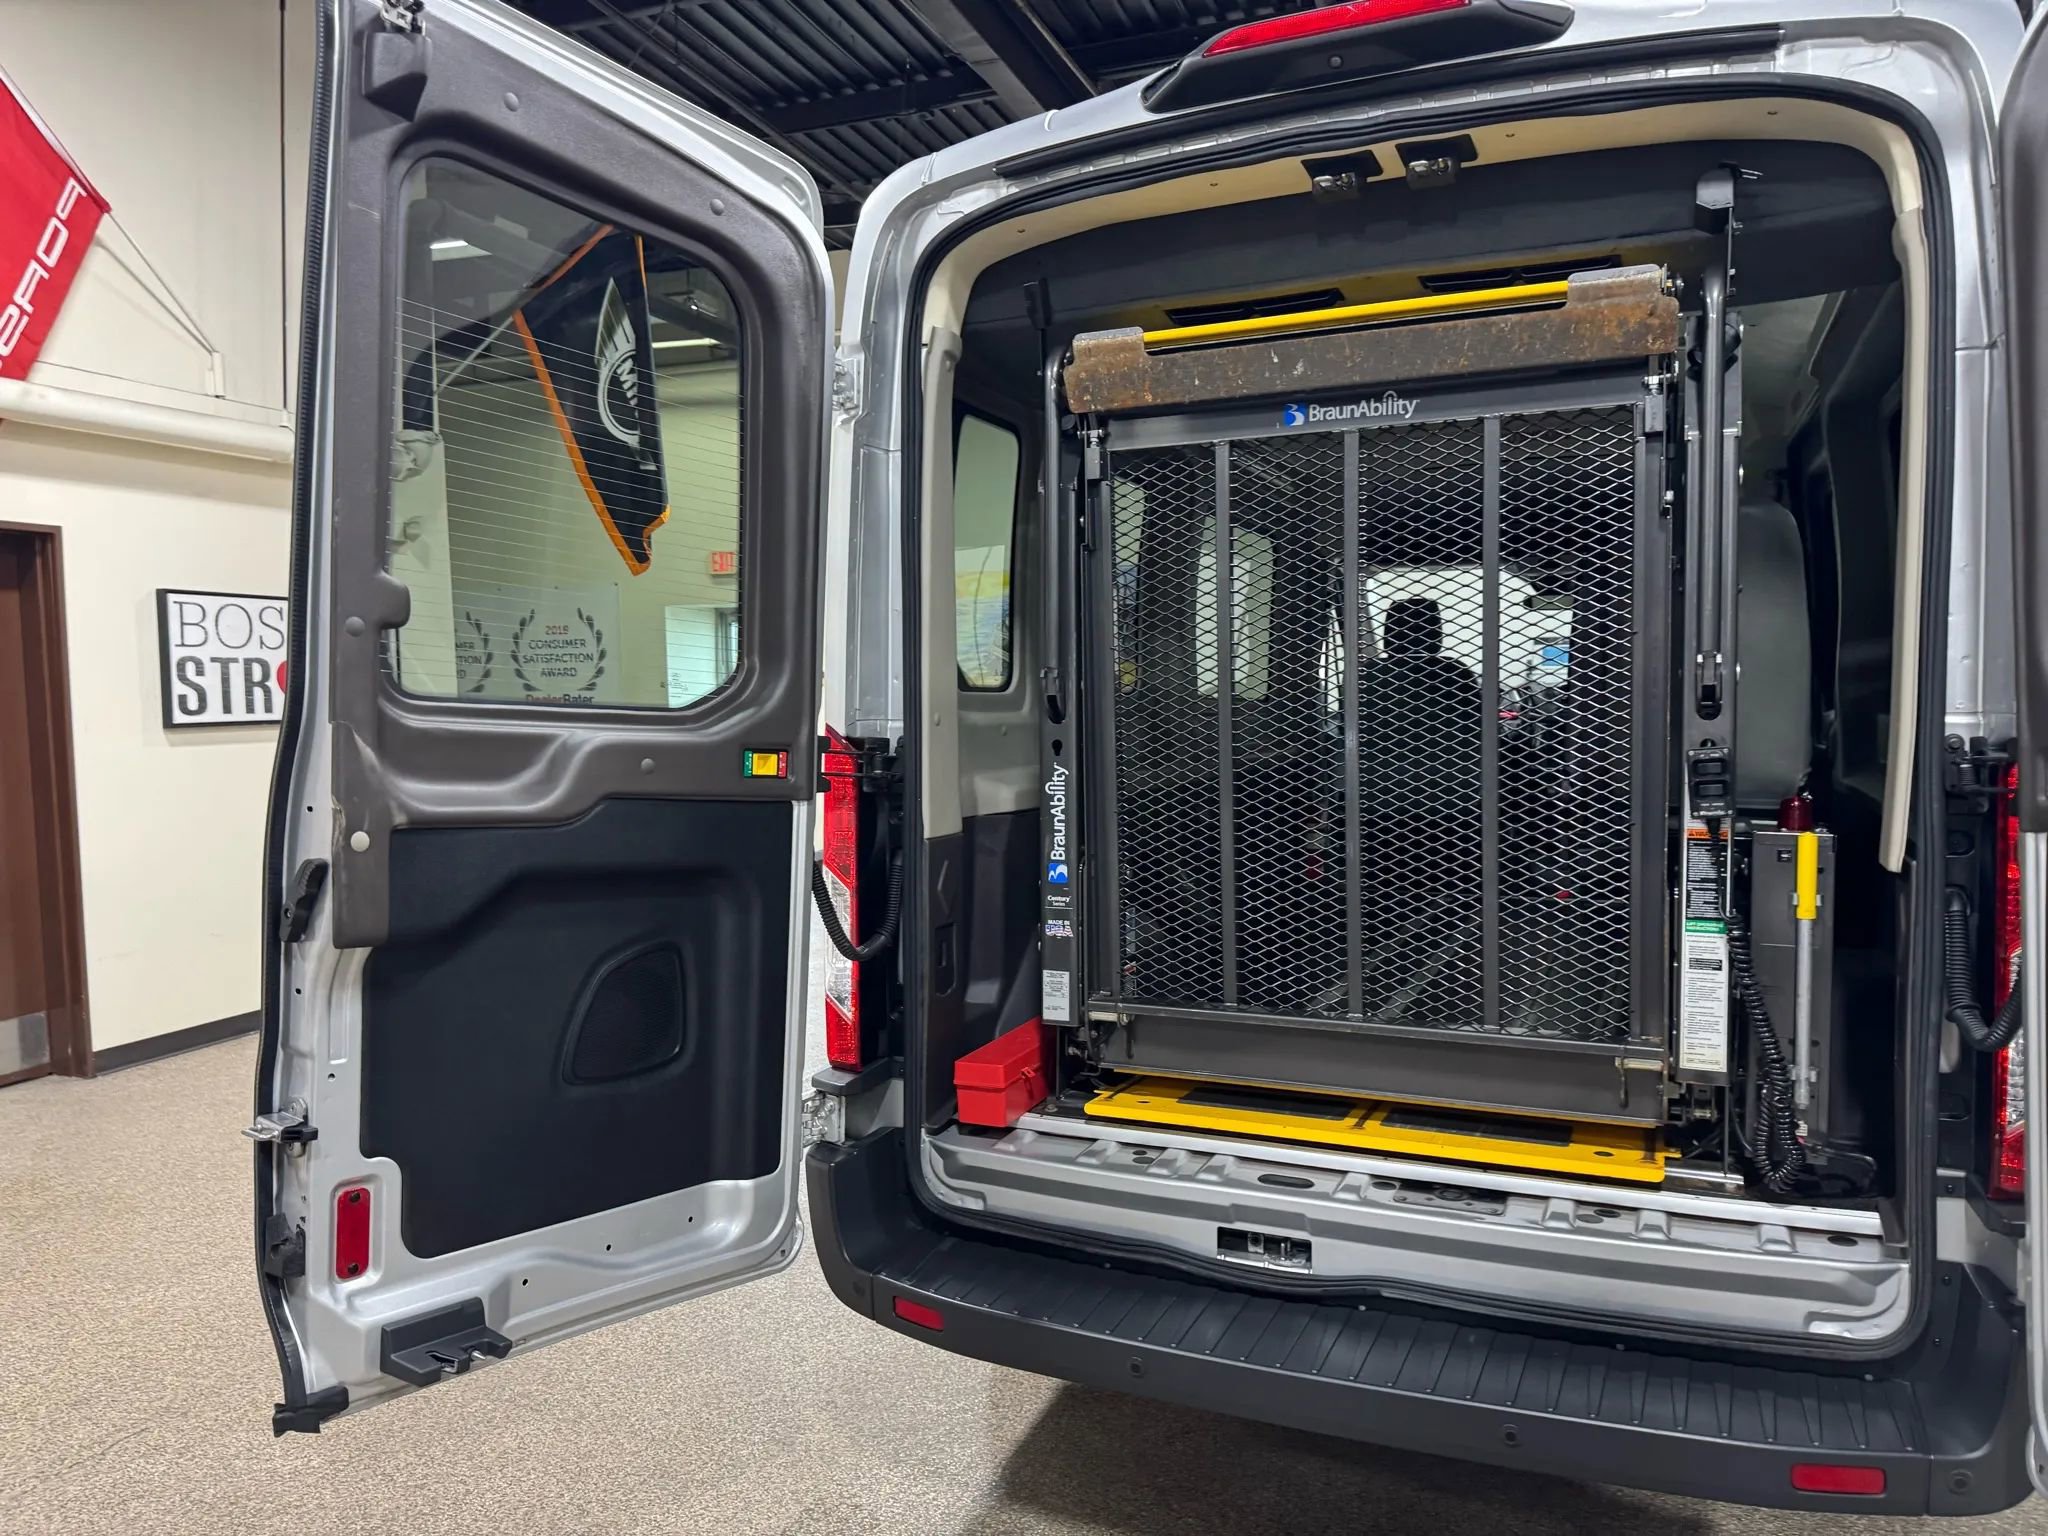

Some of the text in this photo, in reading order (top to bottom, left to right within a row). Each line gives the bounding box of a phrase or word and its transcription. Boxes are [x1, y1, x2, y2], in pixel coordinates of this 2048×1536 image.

[1309, 391, 1418, 421] BraunAbility
[173, 600, 285, 650] BOS
[528, 638, 587, 650] CONSUMER
[522, 653, 594, 664] SATISFACTION
[540, 667, 577, 677] AWARD
[1045, 764, 1069, 861] BraunAbility
[1047, 894, 1071, 903] Century
